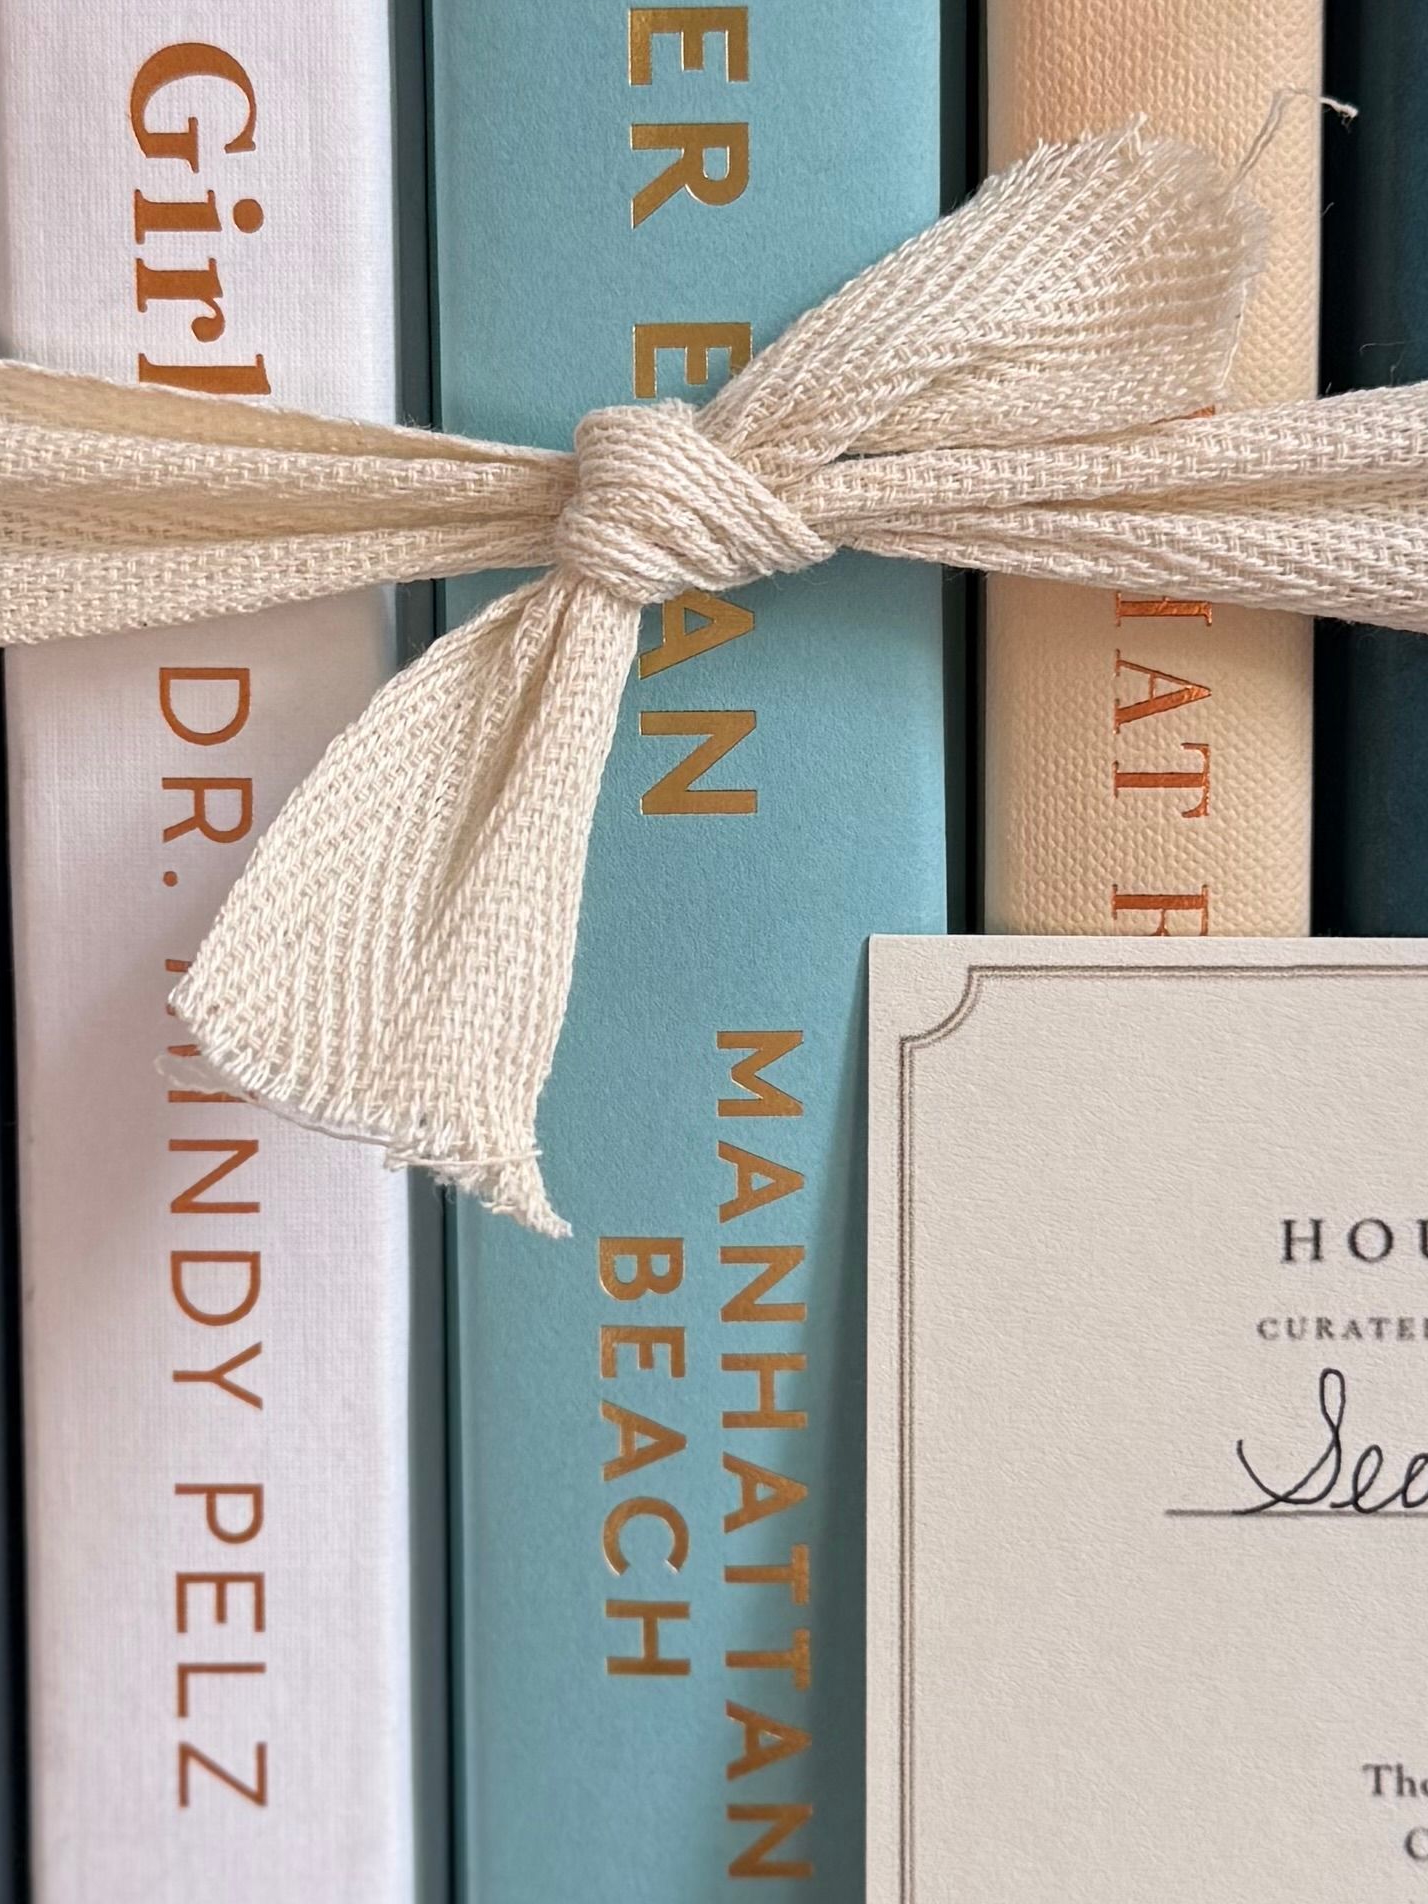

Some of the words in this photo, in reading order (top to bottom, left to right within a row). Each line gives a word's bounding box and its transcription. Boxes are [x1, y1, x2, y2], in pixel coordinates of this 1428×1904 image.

[129, 42, 272, 395] Girl
[158, 666, 254, 892] DR.
[633, 322, 758, 816] EAN
[166, 958, 264, 1411] INDY
[173, 1482, 268, 1809] PELZ
[598, 1235, 692, 1678] BEACH
[716, 1030, 814, 1881] MANHATTAN
